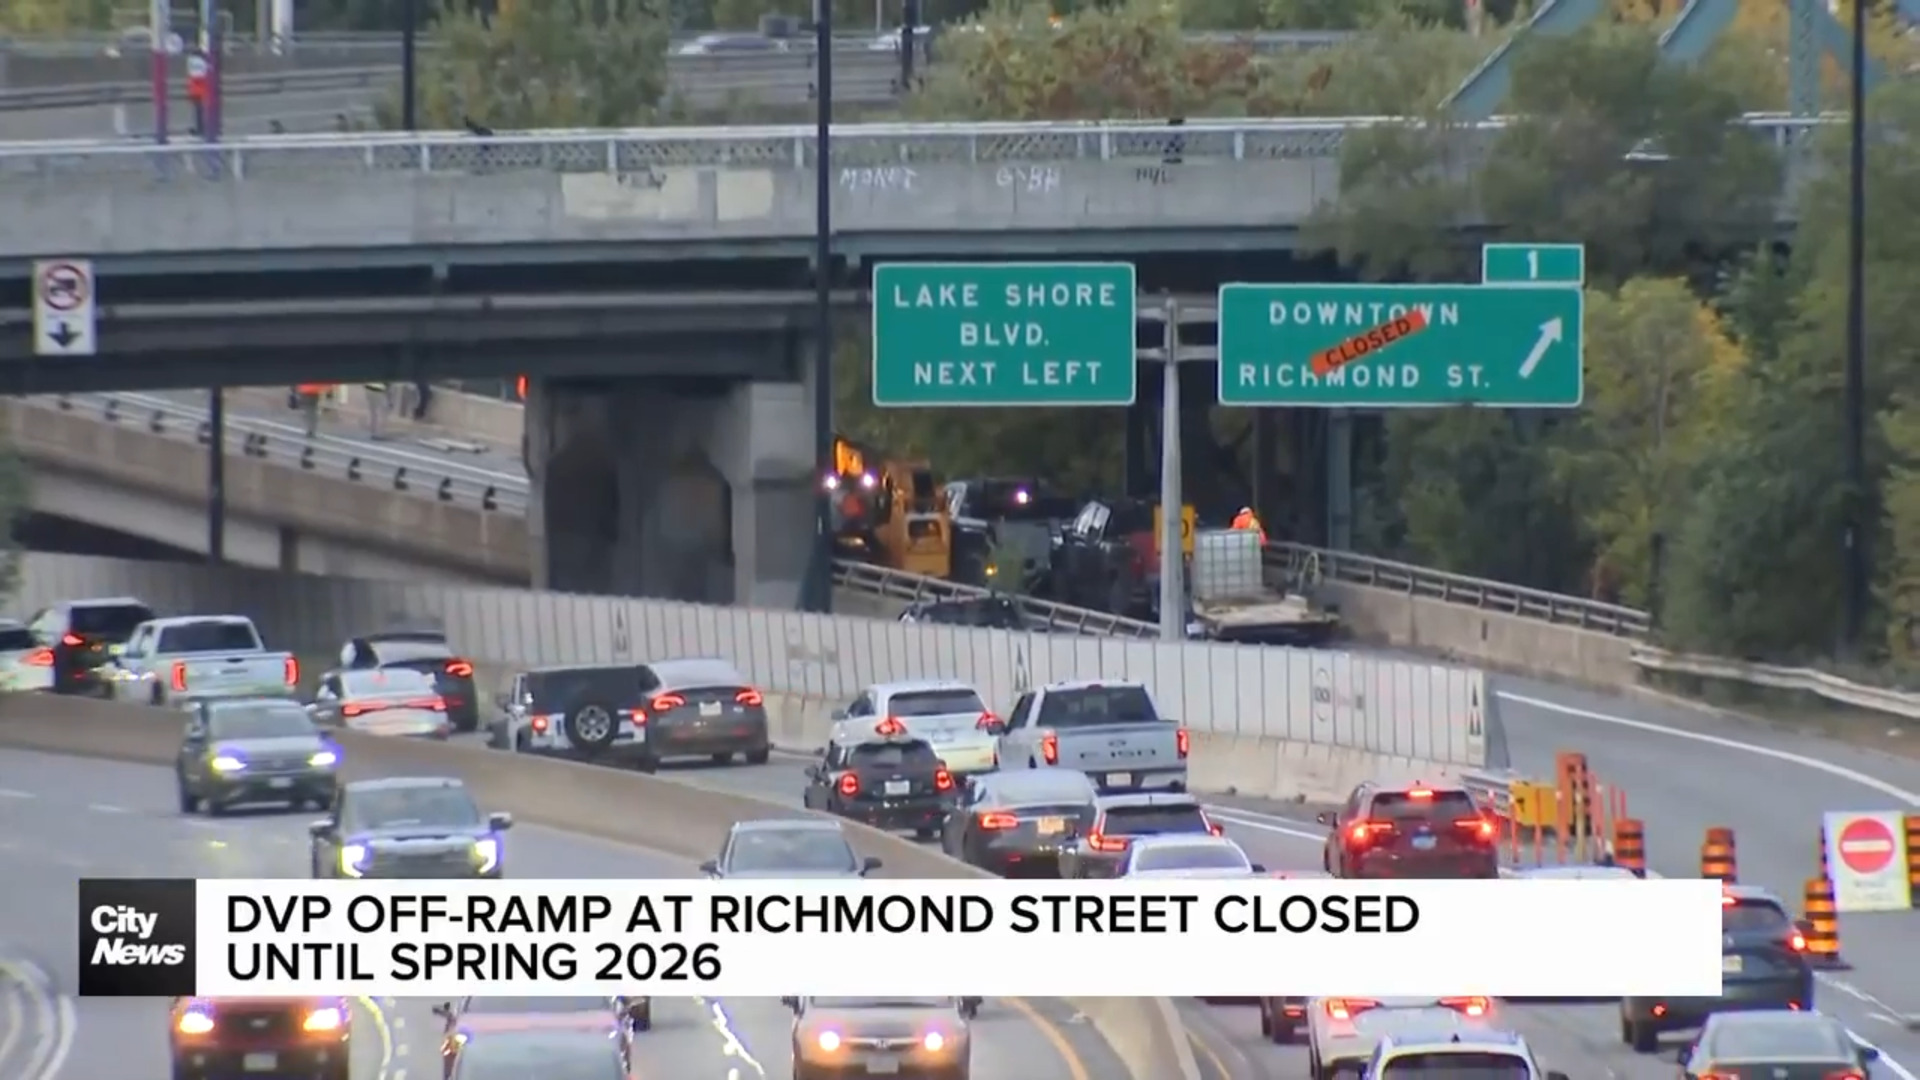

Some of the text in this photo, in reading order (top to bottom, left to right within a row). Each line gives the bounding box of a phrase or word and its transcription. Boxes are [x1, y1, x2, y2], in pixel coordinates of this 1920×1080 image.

[1527, 249, 1539, 280] 1
[893, 283, 1117, 308] LAKE SHORE
[1268, 301, 1459, 326] DOWNTOWN
[960, 322, 1050, 347] BLVD.
[1325, 317, 1412, 367] CLOSED
[914, 361, 1103, 386] NEXT LEFT
[1239, 363, 1491, 389] RICHMOND ST.
